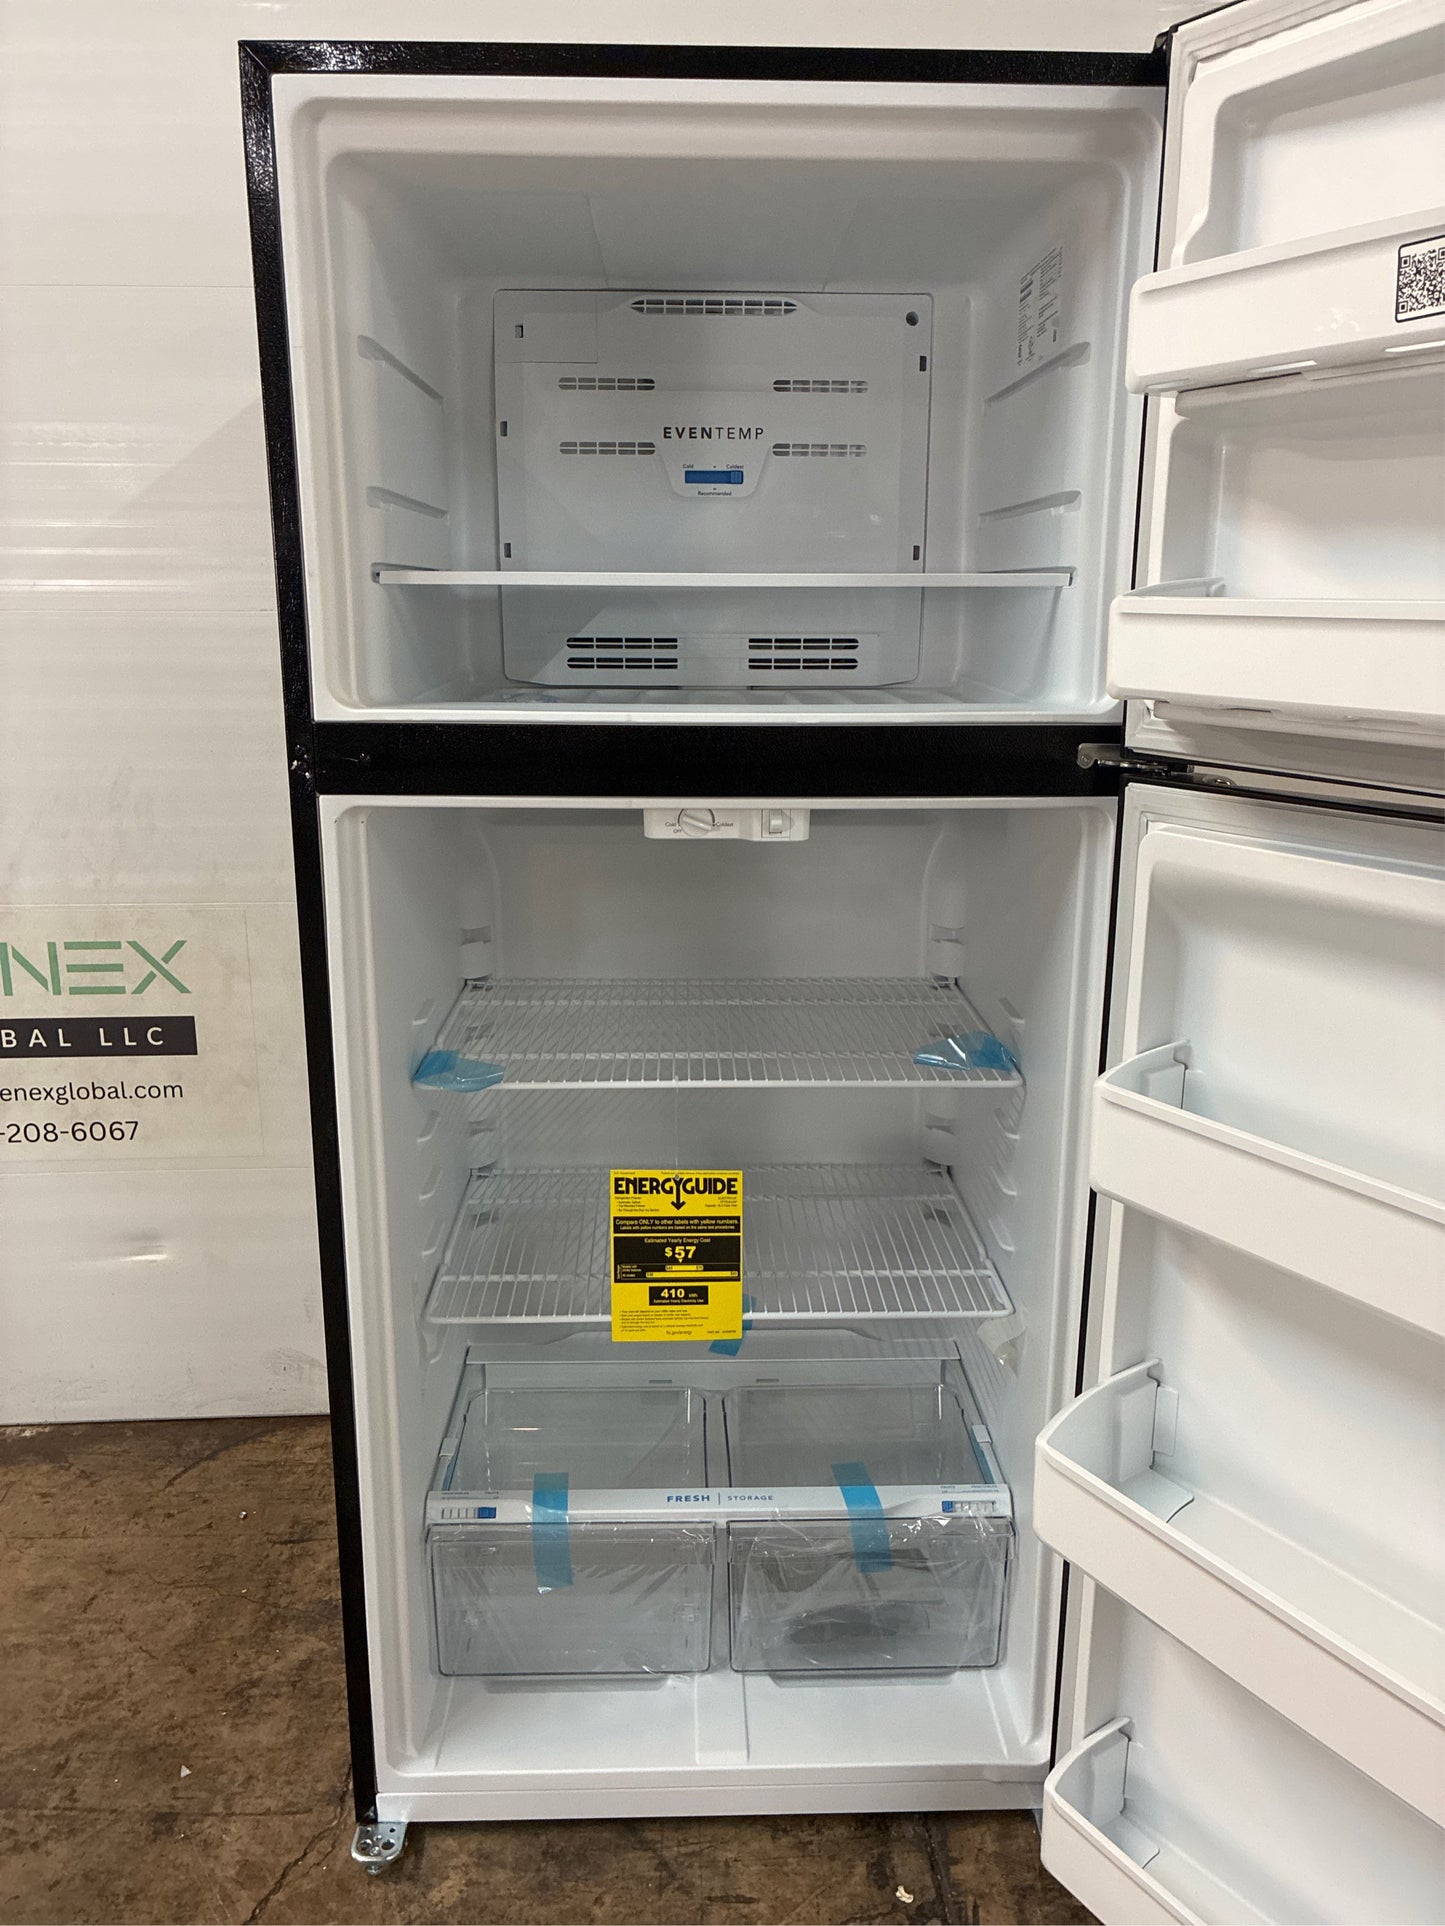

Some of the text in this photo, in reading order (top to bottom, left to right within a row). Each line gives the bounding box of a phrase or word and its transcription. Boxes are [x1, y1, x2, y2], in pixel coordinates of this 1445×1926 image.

[663, 426, 764, 440] EVENTEMP
[0, 1027, 165, 1048] BAL LLC
[0, 1081, 184, 1105] enexglobal.com
[661, 1288, 686, 1298] 410
[666, 1494, 775, 1503] FRESH STORAGE
